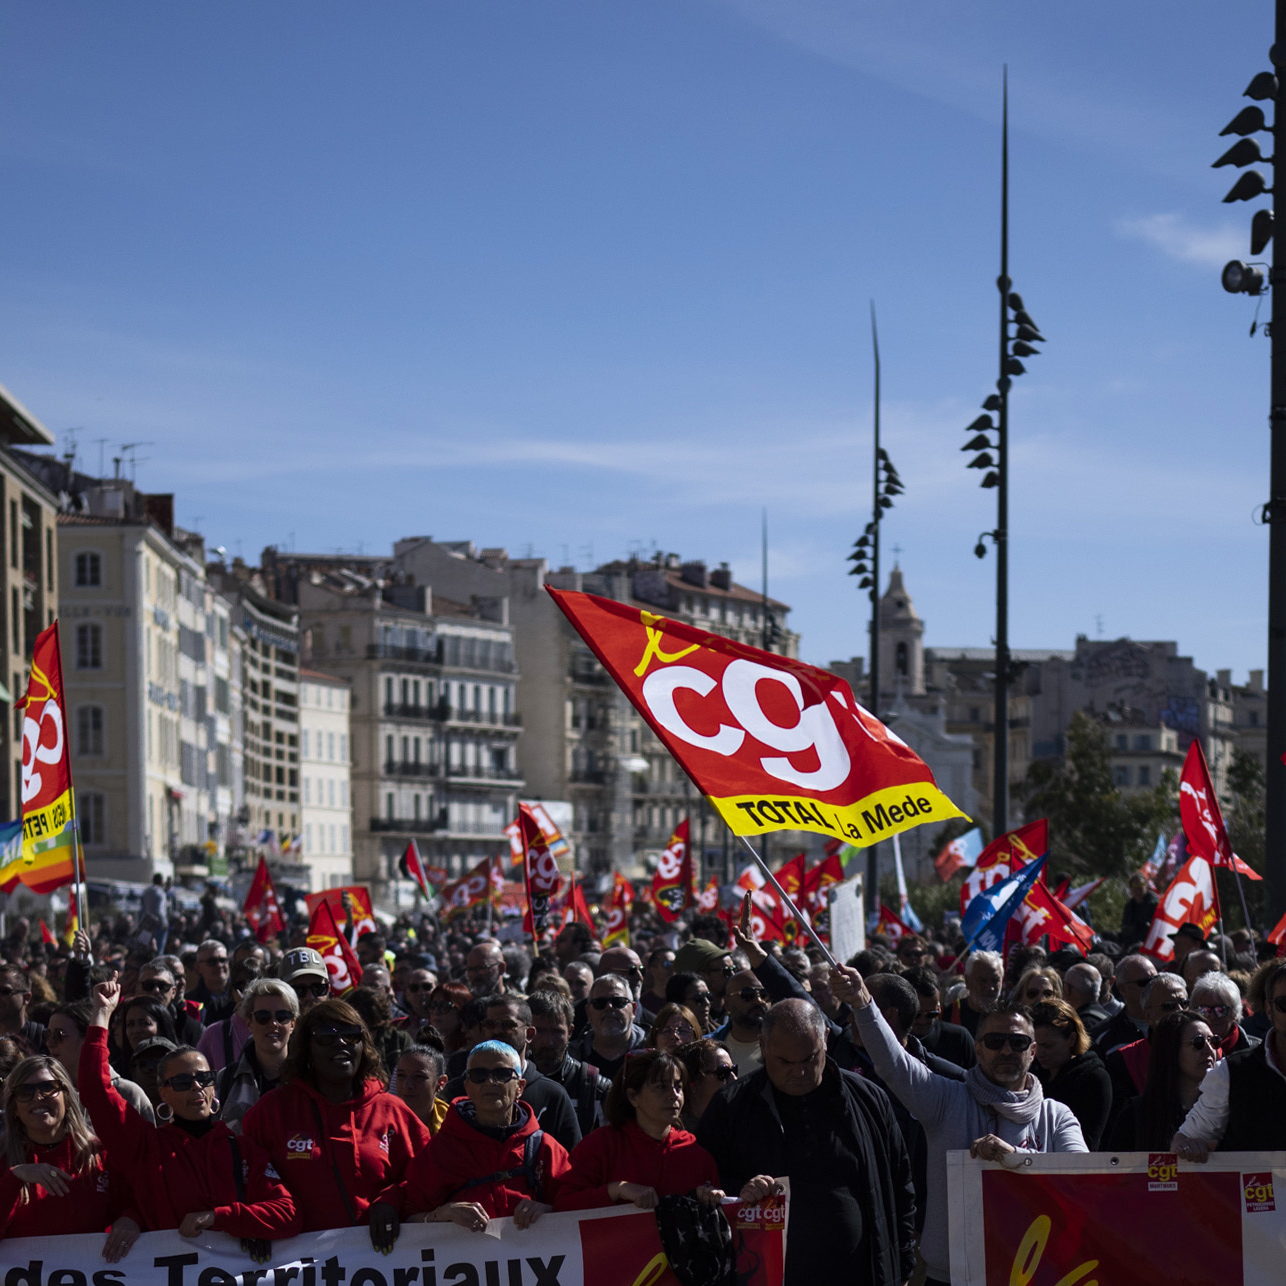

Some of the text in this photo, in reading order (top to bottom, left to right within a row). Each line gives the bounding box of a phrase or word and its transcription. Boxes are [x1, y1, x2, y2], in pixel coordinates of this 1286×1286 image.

[736, 794, 933, 840] TOTAL La Mede
[288, 951, 320, 966] TBL
[286, 1138, 313, 1153] cgt
[1147, 1164, 1178, 1182] cgt
[1244, 1184, 1274, 1203] cgt
[737, 1204, 762, 1223] cgt
[763, 1204, 786, 1223] cgt
